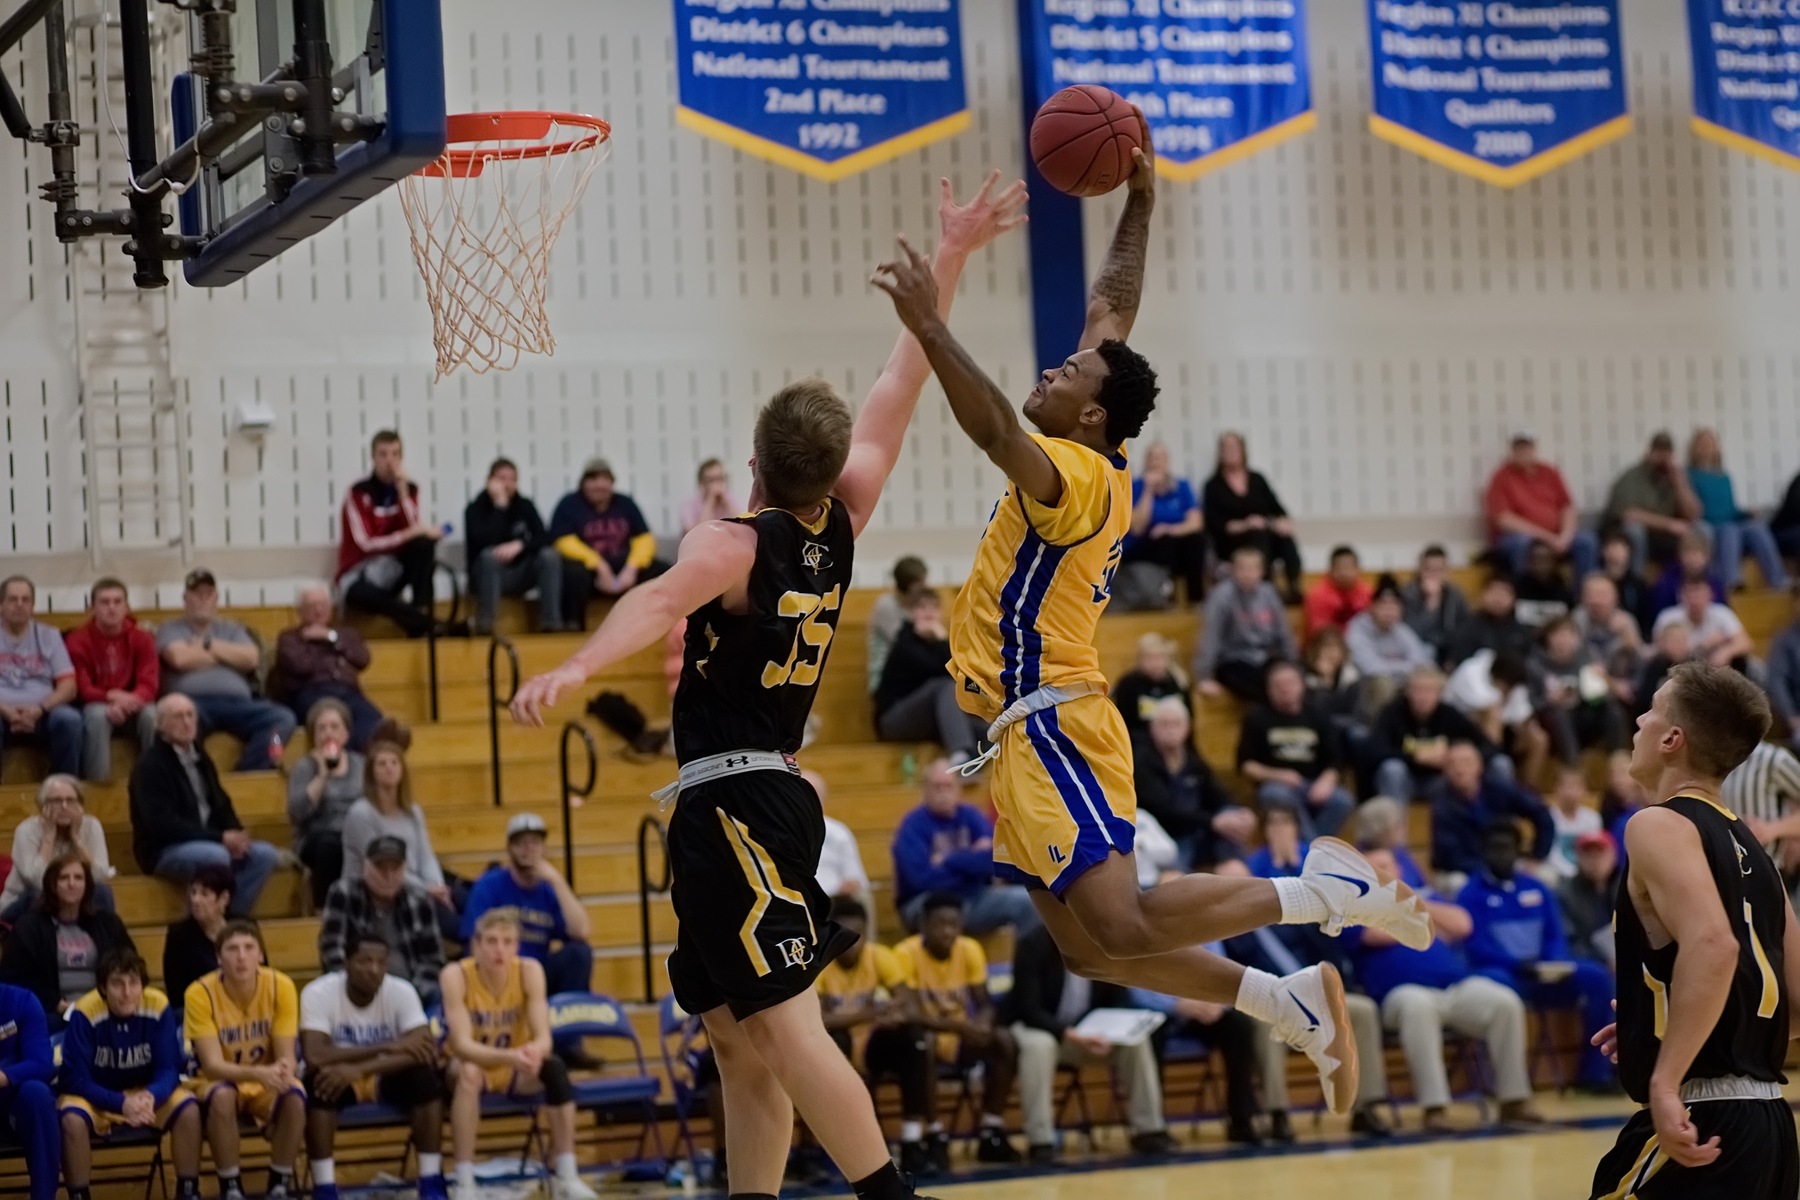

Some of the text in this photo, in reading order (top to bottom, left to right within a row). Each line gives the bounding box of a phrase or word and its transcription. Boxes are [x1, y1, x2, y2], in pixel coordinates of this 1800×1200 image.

[1375, 0, 1455, 30] Region
[1485, 2, 1610, 30] Champions
[689, 16, 949, 51] District 6 Champions
[1050, 24, 1138, 51] District
[1161, 25, 1293, 56] Champions
[1381, 29, 1462, 59] District
[1484, 33, 1610, 64] Champions
[693, 52, 950, 80] National Tournament
[1053, 58, 1296, 84] National Tournament
[1383, 62, 1611, 92] National Tournament
[764, 87, 887, 114] 2nd Place
[1167, 91, 1235, 118] Place
[1444, 98, 1556, 128] Qualifiers
[798, 122, 860, 149] 1992
[1473, 130, 1534, 157] 2000
[761, 583, 840, 689] 35
